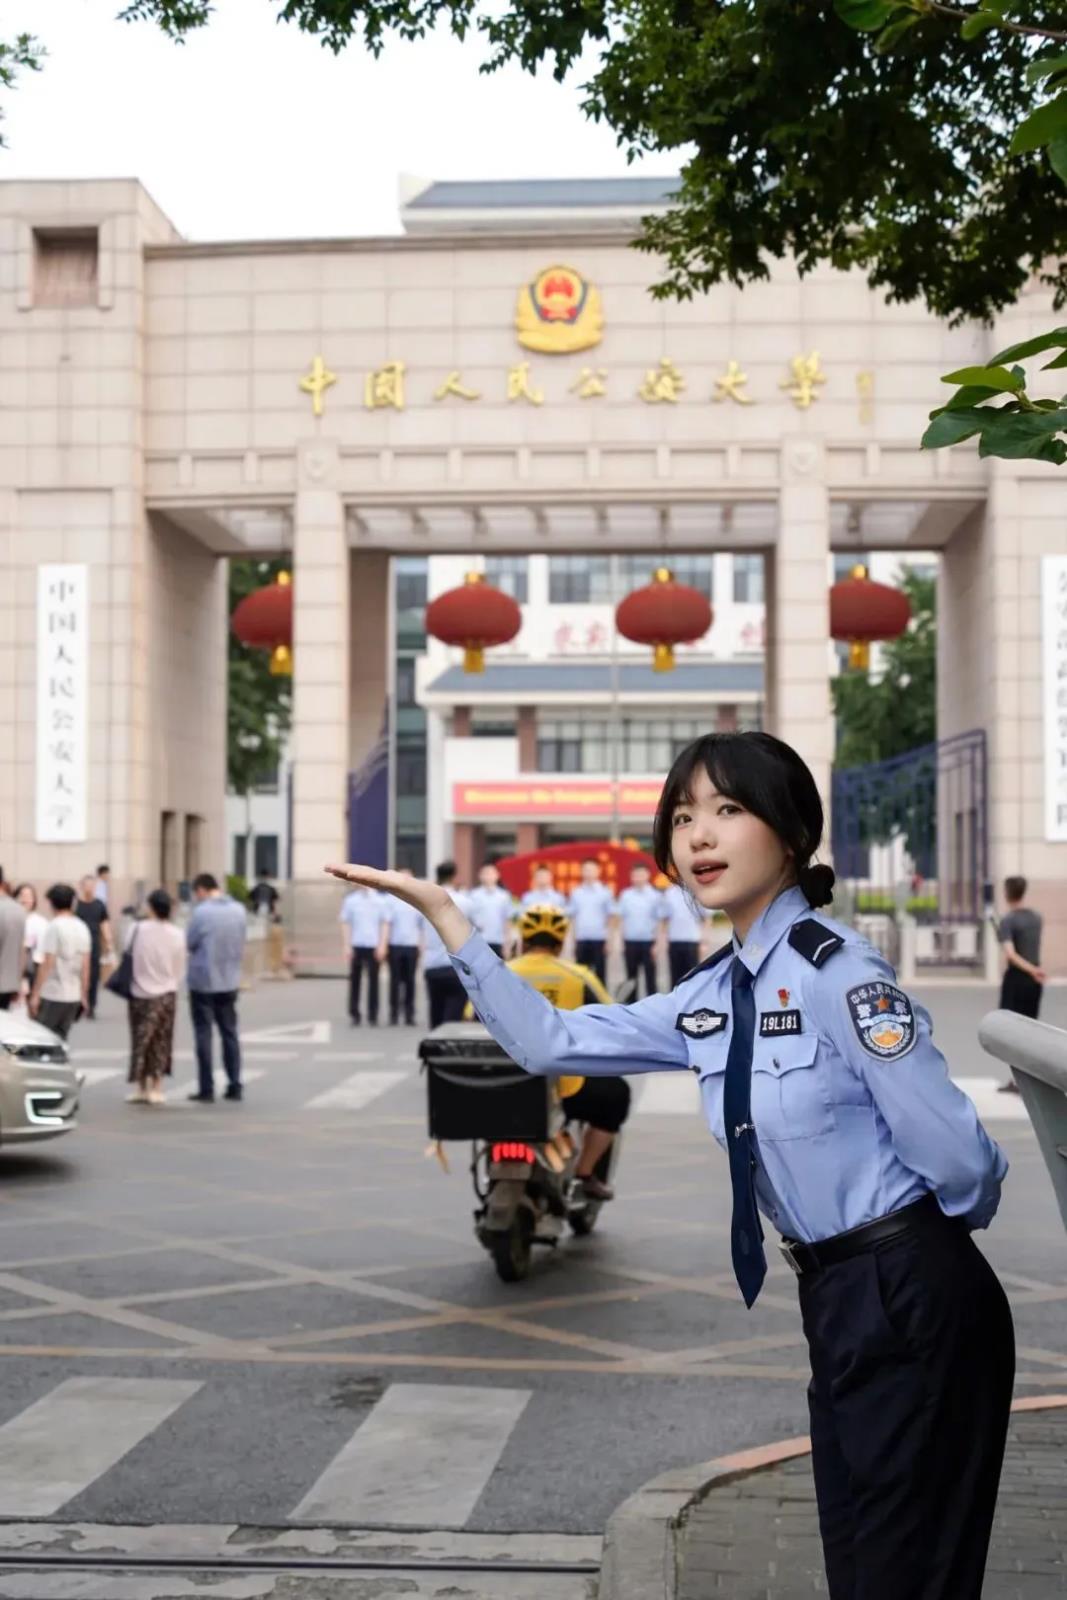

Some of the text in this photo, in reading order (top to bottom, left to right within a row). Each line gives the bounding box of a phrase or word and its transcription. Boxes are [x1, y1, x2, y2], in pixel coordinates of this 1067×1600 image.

[48, 580, 76, 829] 中国人民公安大学
[762, 1014, 798, 1031] 19L181
